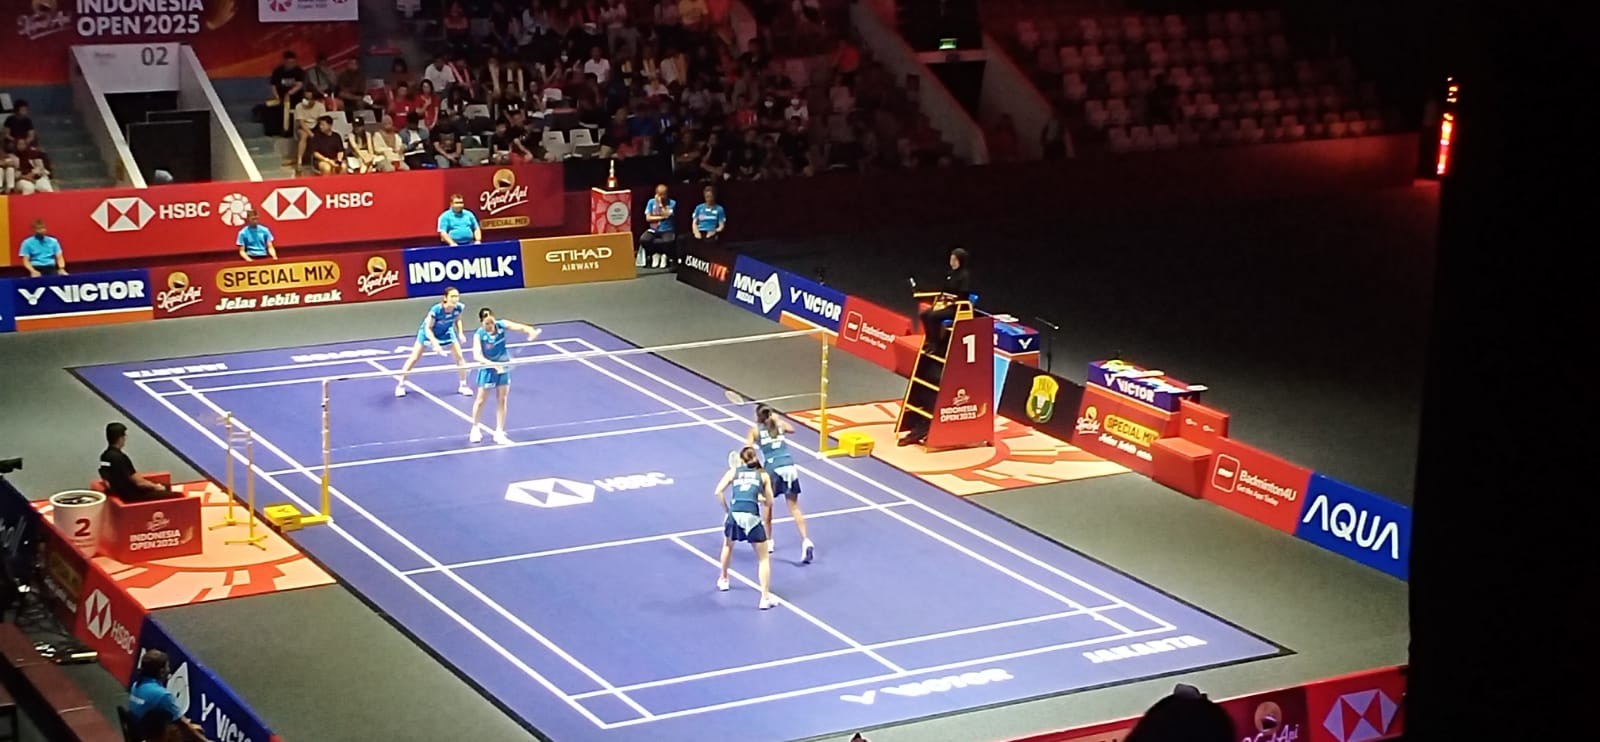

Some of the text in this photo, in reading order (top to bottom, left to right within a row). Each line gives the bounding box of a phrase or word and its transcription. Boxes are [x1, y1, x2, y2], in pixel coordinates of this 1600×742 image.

[76, 0, 204, 14] INDONESIA
[77, 15, 141, 36] OPEN
[144, 14, 200, 34] 2025
[141, 47, 169, 66] 02
[159, 202, 210, 219] HSBC
[326, 192, 374, 209] HSBC
[545, 247, 613, 263] ETIHAD
[561, 261, 600, 272] AIRWAYS
[223, 264, 336, 288] SPECIAL MIX
[409, 256, 515, 285] INDOMILK
[50, 280, 145, 303] VICTOR
[734, 273, 765, 297] MNC
[215, 289, 342, 311] Jelas lebih enak
[803, 292, 842, 322] VICTOR
[962, 334, 976, 363] 1
[1116, 378, 1155, 403] VICTOR
[1107, 417, 1141, 440] SPECIAL
[74, 518, 91, 537] 2
[129, 529, 181, 542] INDONESIA
[1302, 495, 1399, 560] AQUA
[110, 620, 136, 655] HSBC
[216, 707, 251, 742] VIC
